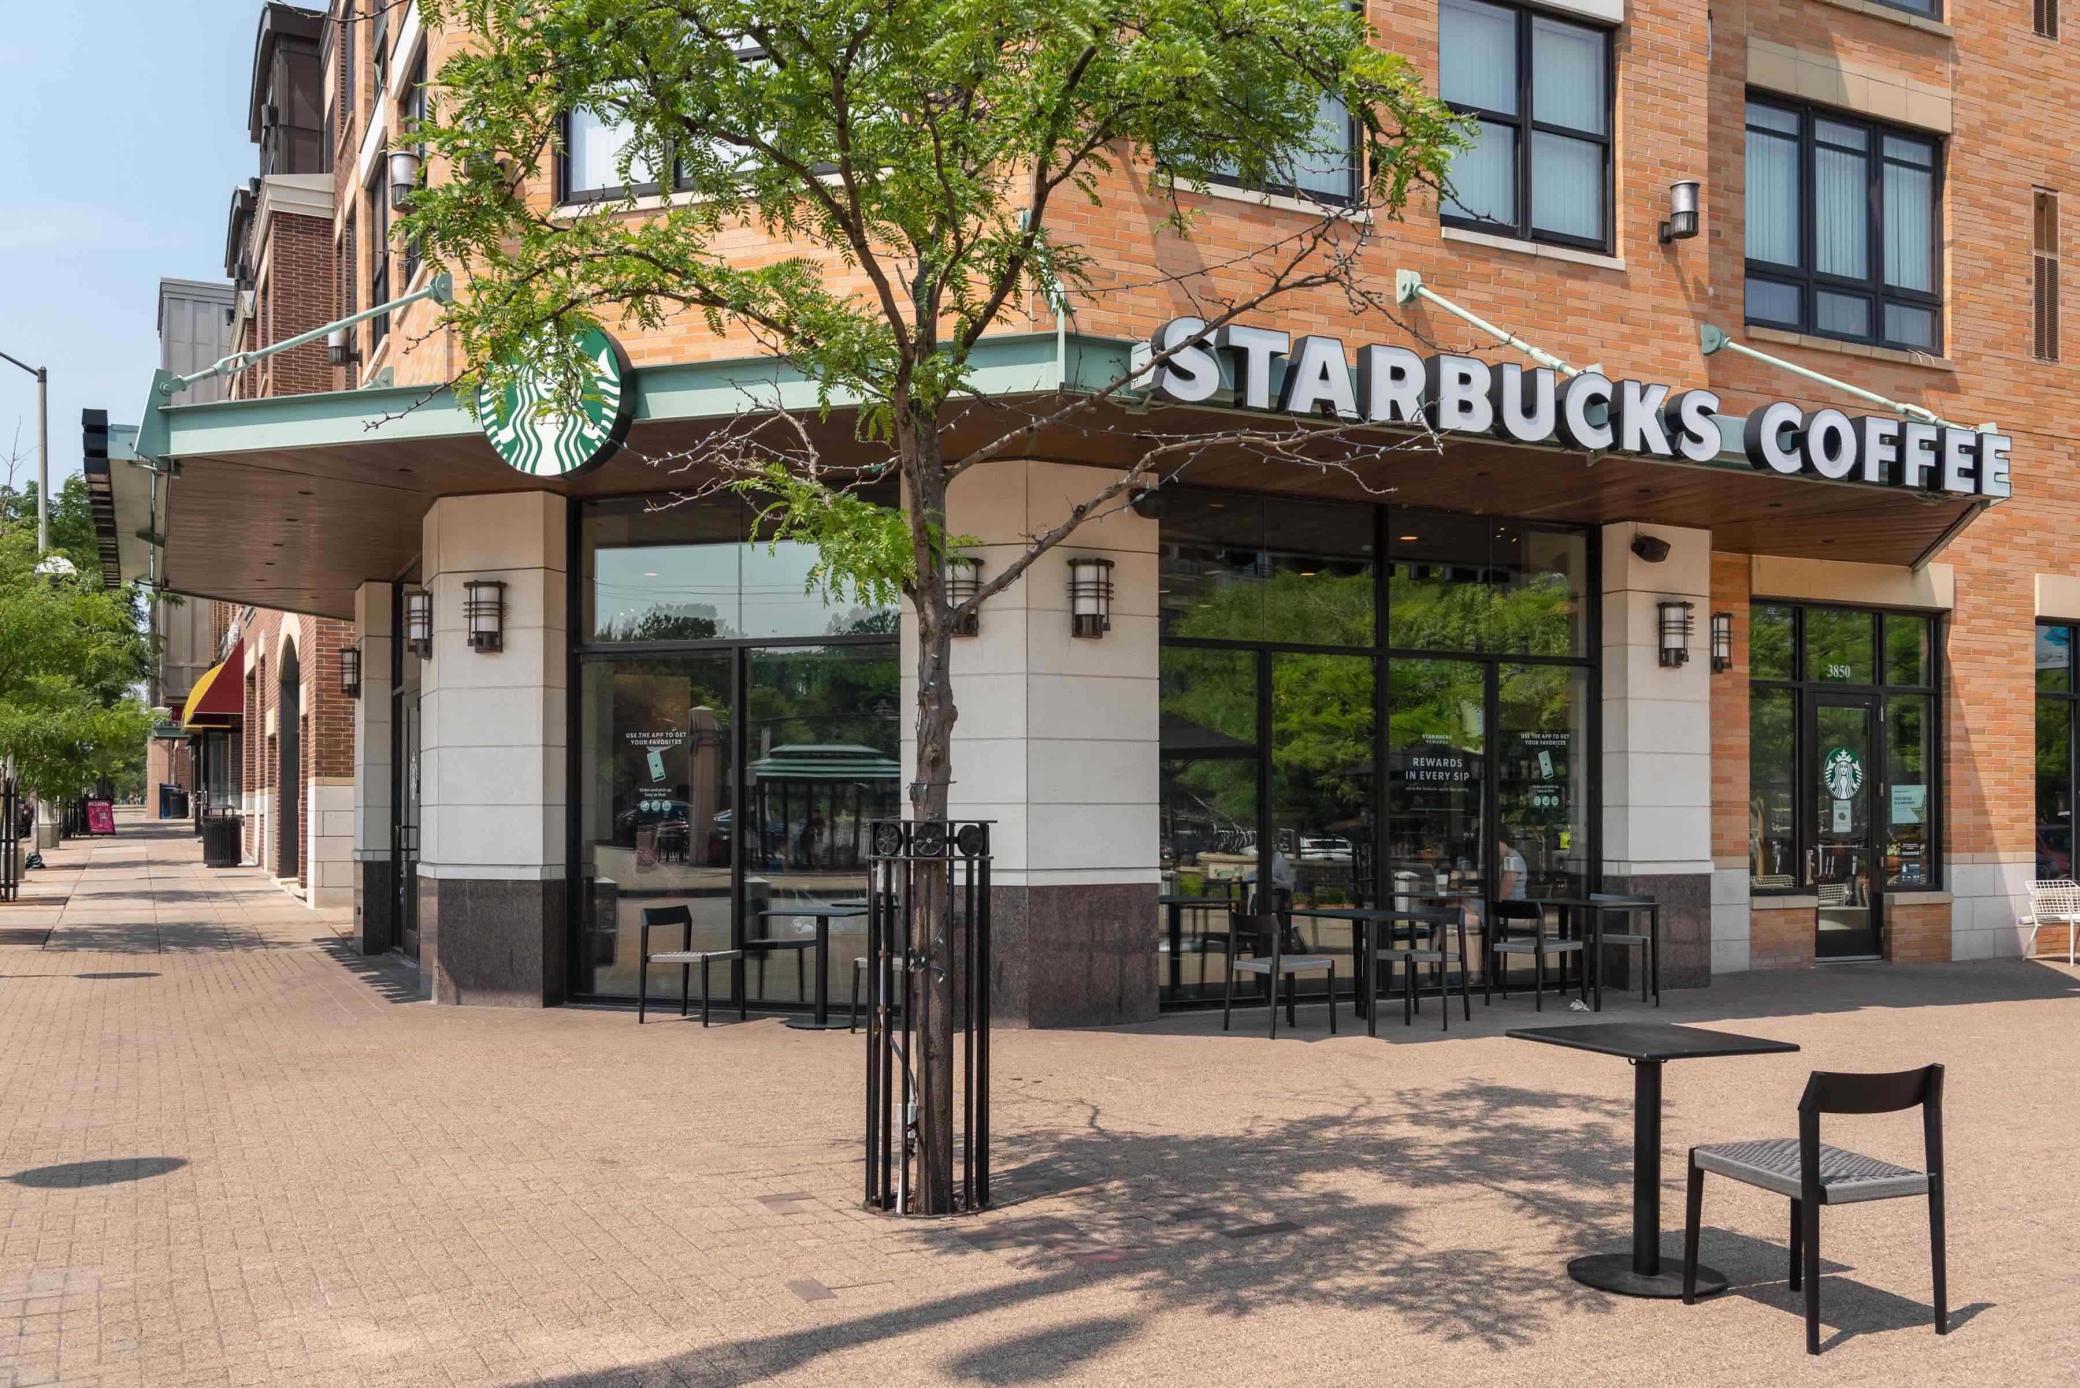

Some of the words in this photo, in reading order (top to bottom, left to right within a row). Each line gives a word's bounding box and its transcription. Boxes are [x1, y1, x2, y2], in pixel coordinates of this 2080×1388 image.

[1155, 315, 1722, 462] STARBUCKS
[1750, 401, 2012, 499] COFFEE
[1826, 664, 1851, 679] 3850
[1412, 757, 1463, 768] REWARDS
[1405, 770, 1416, 780] IN
[1420, 770, 1451, 781] EVERY
[1454, 771, 1470, 781] SIP
